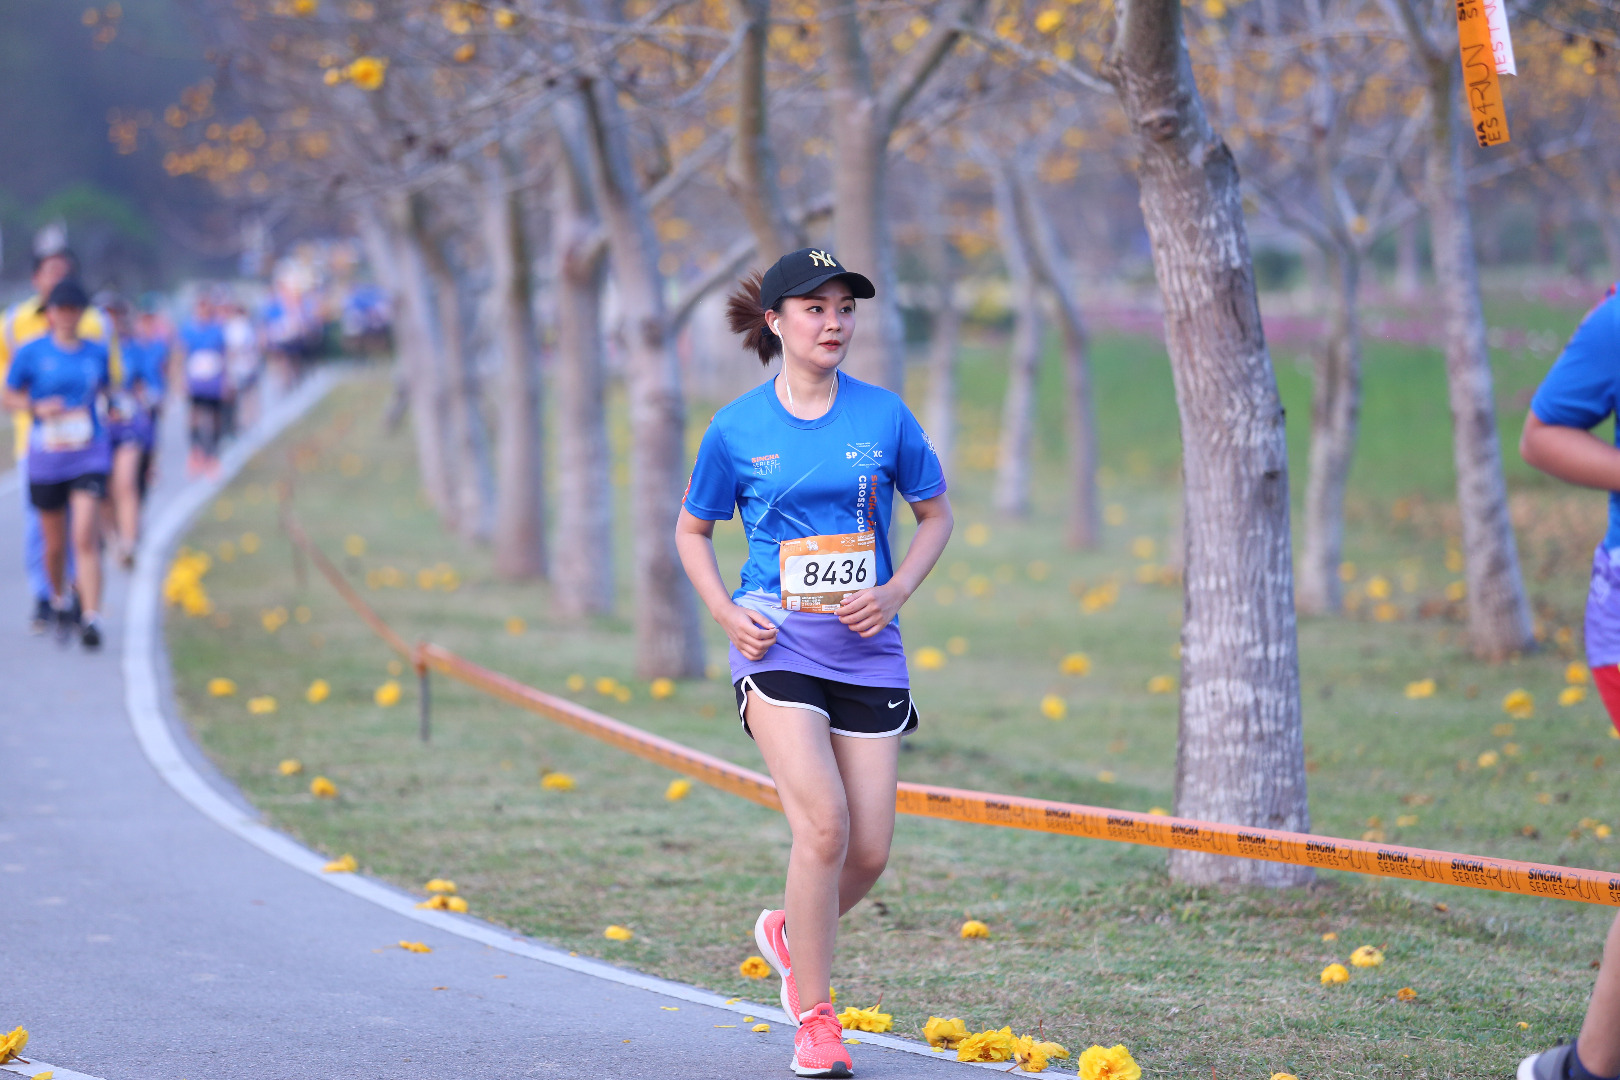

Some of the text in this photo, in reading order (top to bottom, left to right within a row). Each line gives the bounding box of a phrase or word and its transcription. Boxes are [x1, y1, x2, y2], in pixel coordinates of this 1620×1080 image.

[808, 250, 837, 268] NY
[751, 453, 780, 463] SINGHA
[845, 450, 883, 459] SP XC
[856, 475, 867, 508] CROSS
[867, 474, 878, 518] SINGHA
[856, 509, 866, 532] COU
[803, 557, 867, 587] 8436
[790, 600, 798, 610] F
[1106, 815, 1134, 827] SINGHA
[1170, 823, 1199, 836] SINGHA
[1237, 831, 1266, 845] SINGHA
[1237, 843, 1269, 857] SERIES
[1305, 840, 1336, 854] SINGHA
[1306, 852, 1339, 866] SERIES
[1377, 849, 1409, 863] SINGHA
[1377, 861, 1412, 876] SERIES
[1451, 858, 1484, 873] SINGHA
[1451, 871, 1487, 886] SERIES
[1528, 868, 1562, 883] SINGHA
[1528, 881, 1566, 896] SERIES
